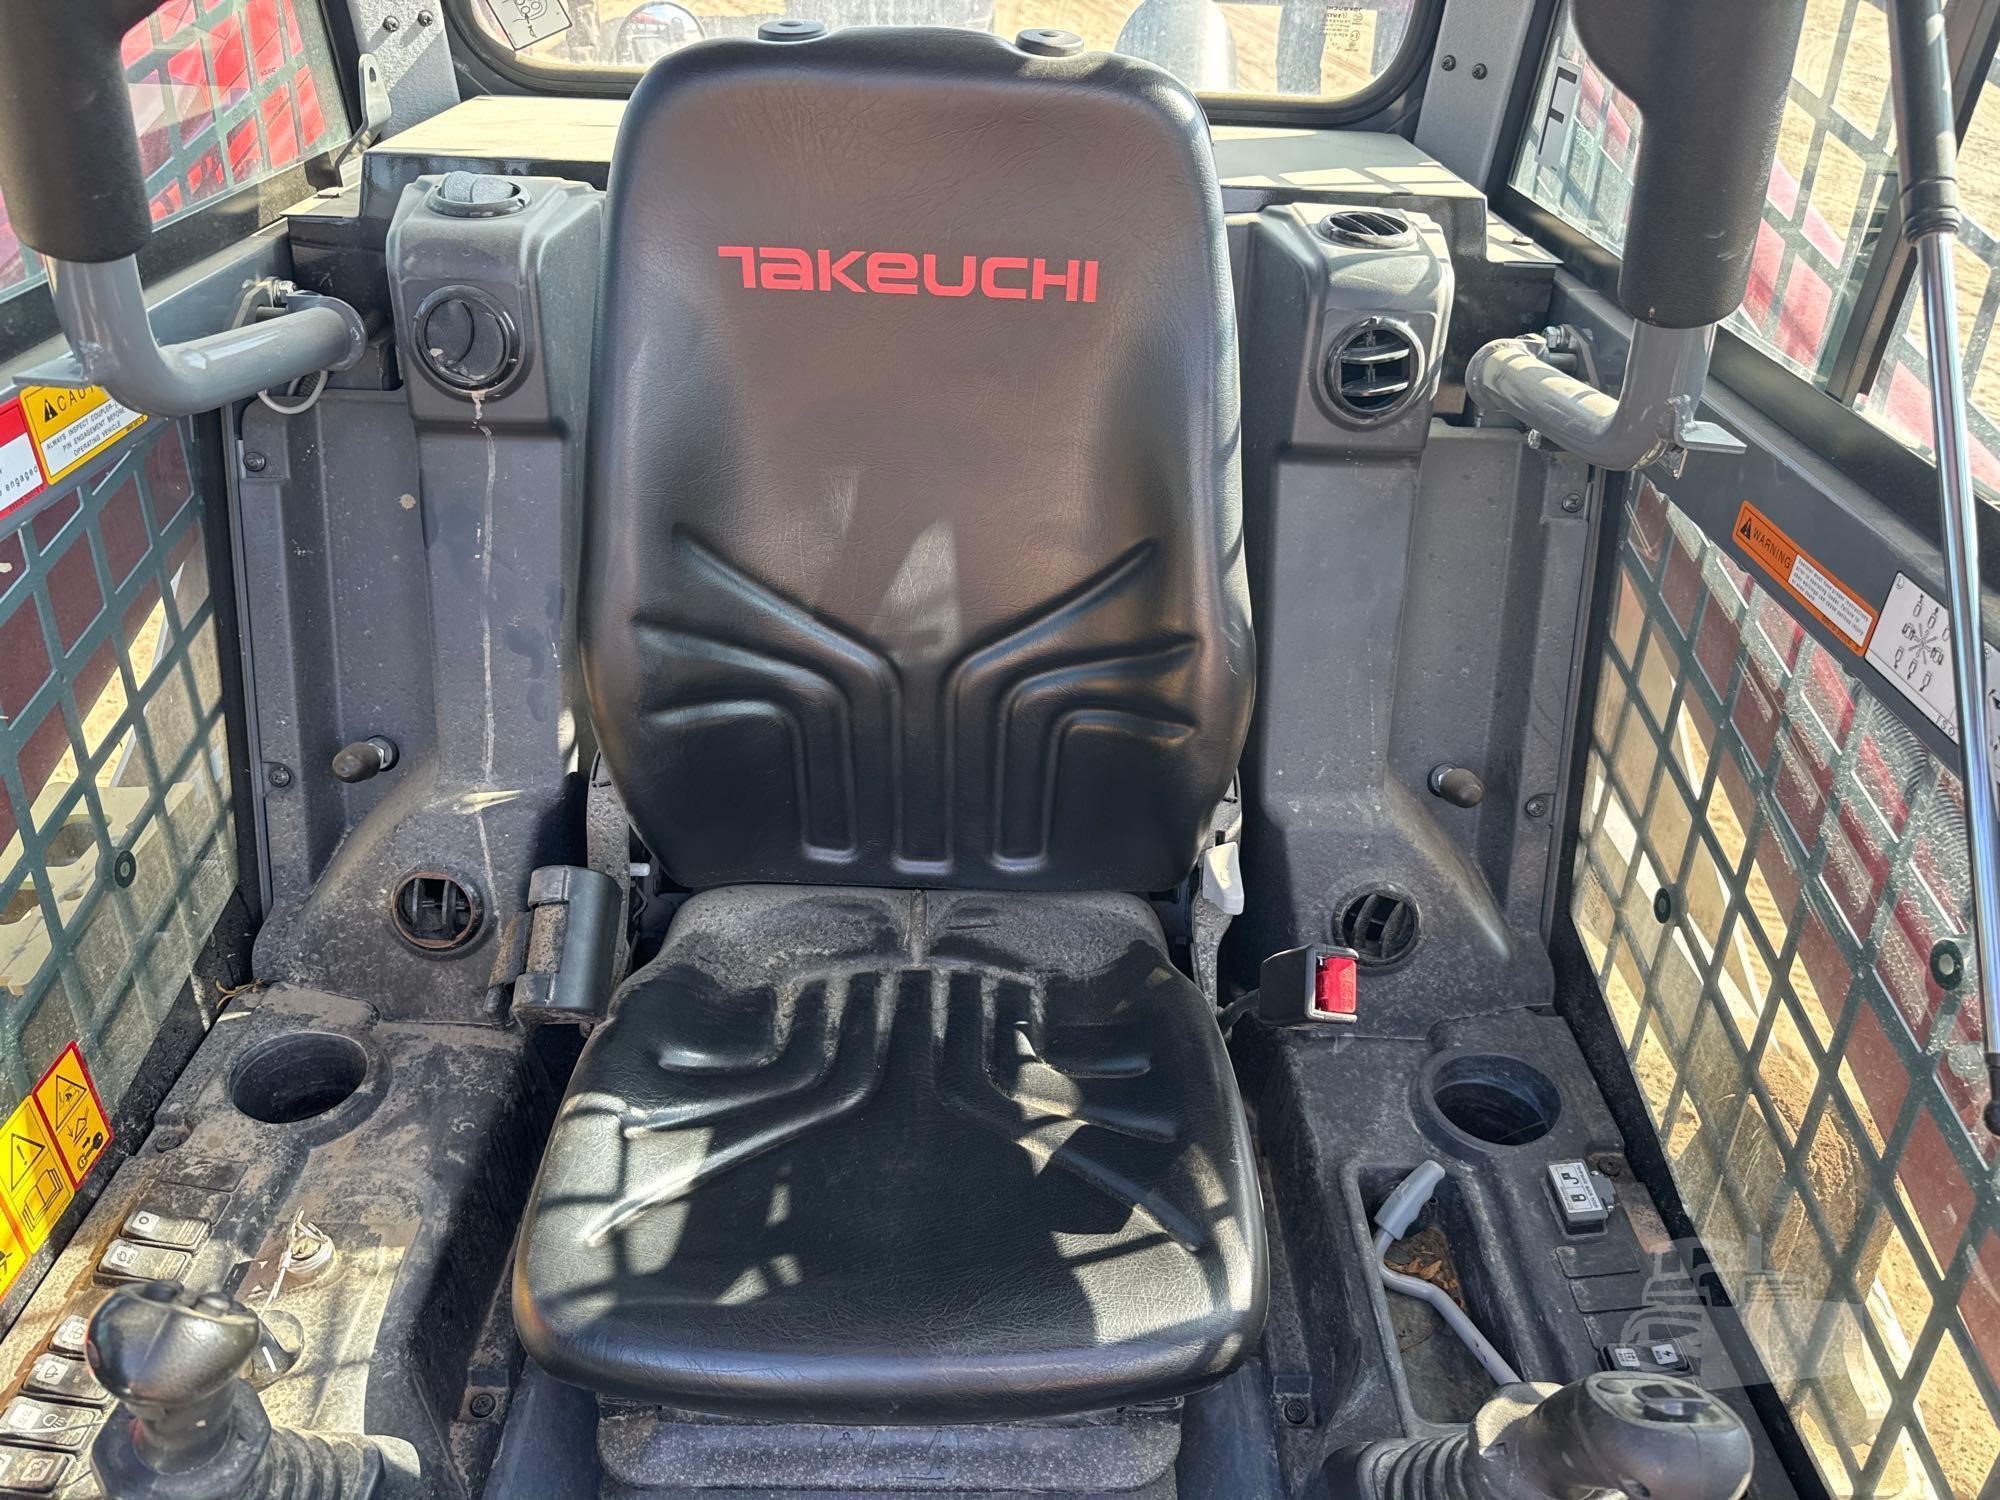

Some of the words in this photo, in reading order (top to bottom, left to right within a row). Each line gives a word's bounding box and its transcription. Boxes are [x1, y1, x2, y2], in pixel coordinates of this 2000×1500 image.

[718, 246, 1099, 303] TAKEUCHI
[46, 433, 67, 449] ALWAYS
[68, 418, 89, 437] INSPECT
[62, 442, 72, 452] PIN
[73, 419, 105, 446] ENGAGEMENT
[73, 434, 100, 457] OPERATING
[101, 420, 122, 437] VEHICLE
[1753, 527, 1791, 569] WARNING
[1935, 715, 1956, 737] ISO
